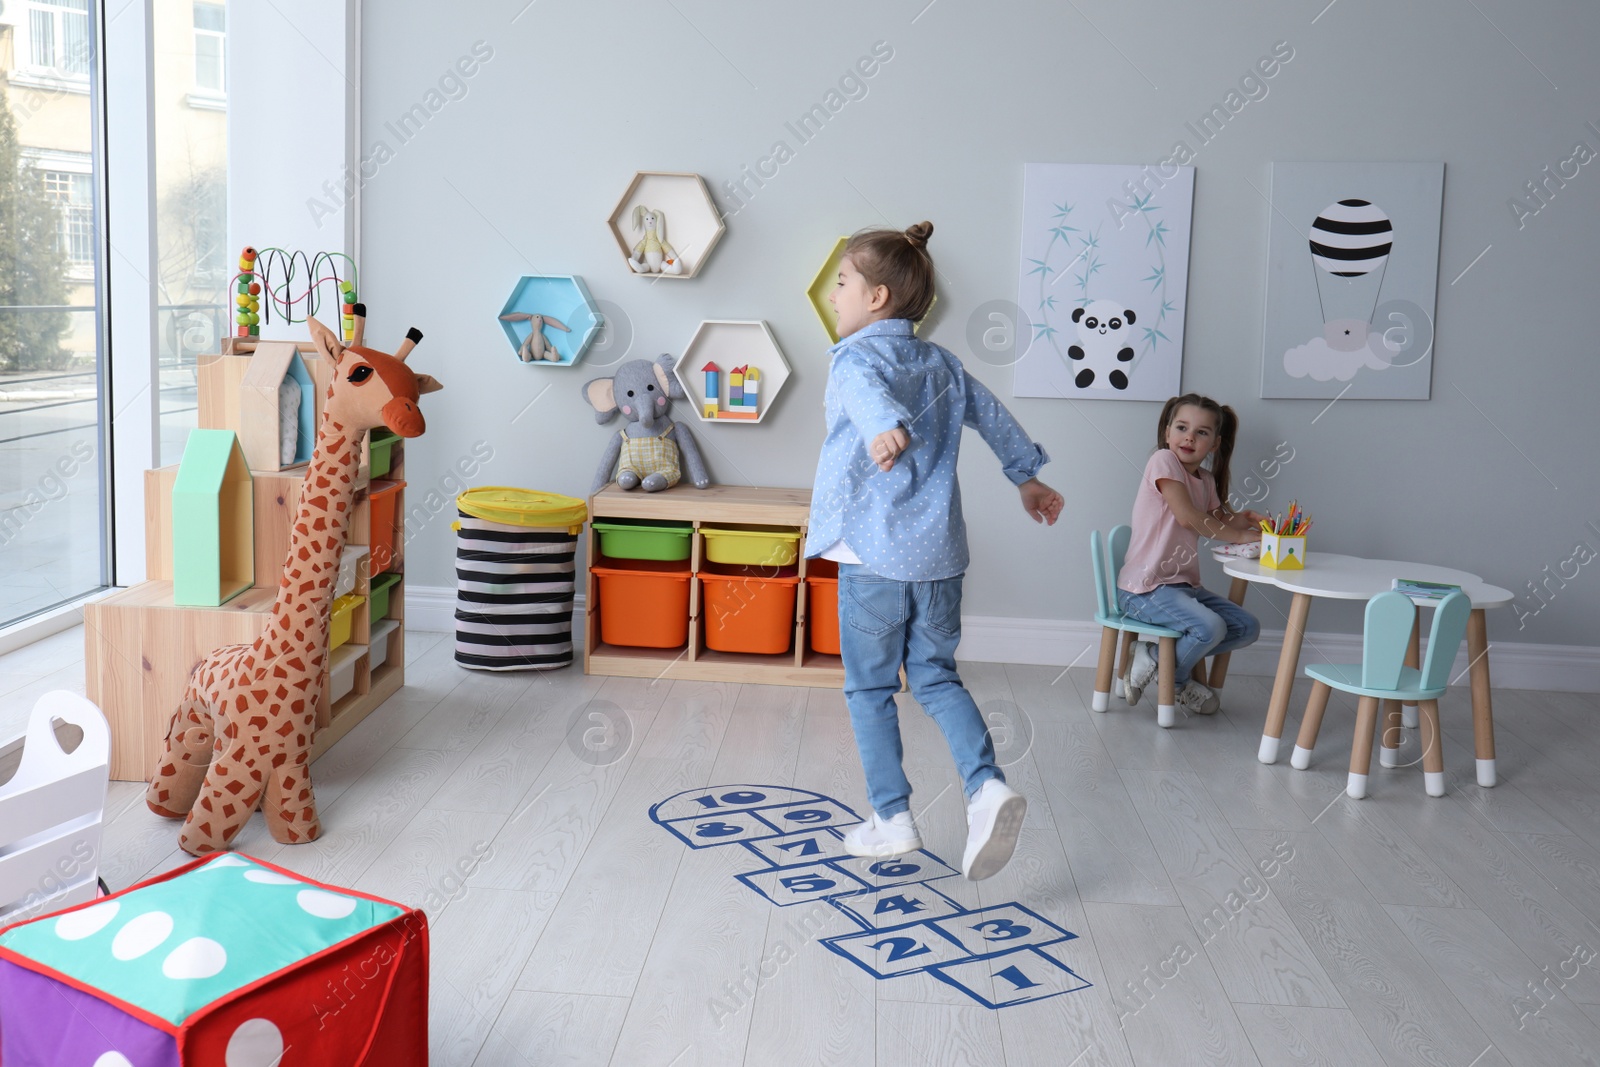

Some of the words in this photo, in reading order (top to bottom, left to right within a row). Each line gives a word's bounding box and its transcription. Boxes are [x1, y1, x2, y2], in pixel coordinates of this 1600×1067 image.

[693, 791, 767, 809] 10
[784, 809, 832, 823] 9
[695, 822, 744, 838] 8
[773, 838, 825, 857] 7
[868, 859, 921, 878] 6
[779, 873, 837, 893] 5
[873, 894, 929, 915] 4
[967, 918, 1032, 943] 3
[864, 937, 931, 963] 2
[990, 965, 1042, 991] 1
